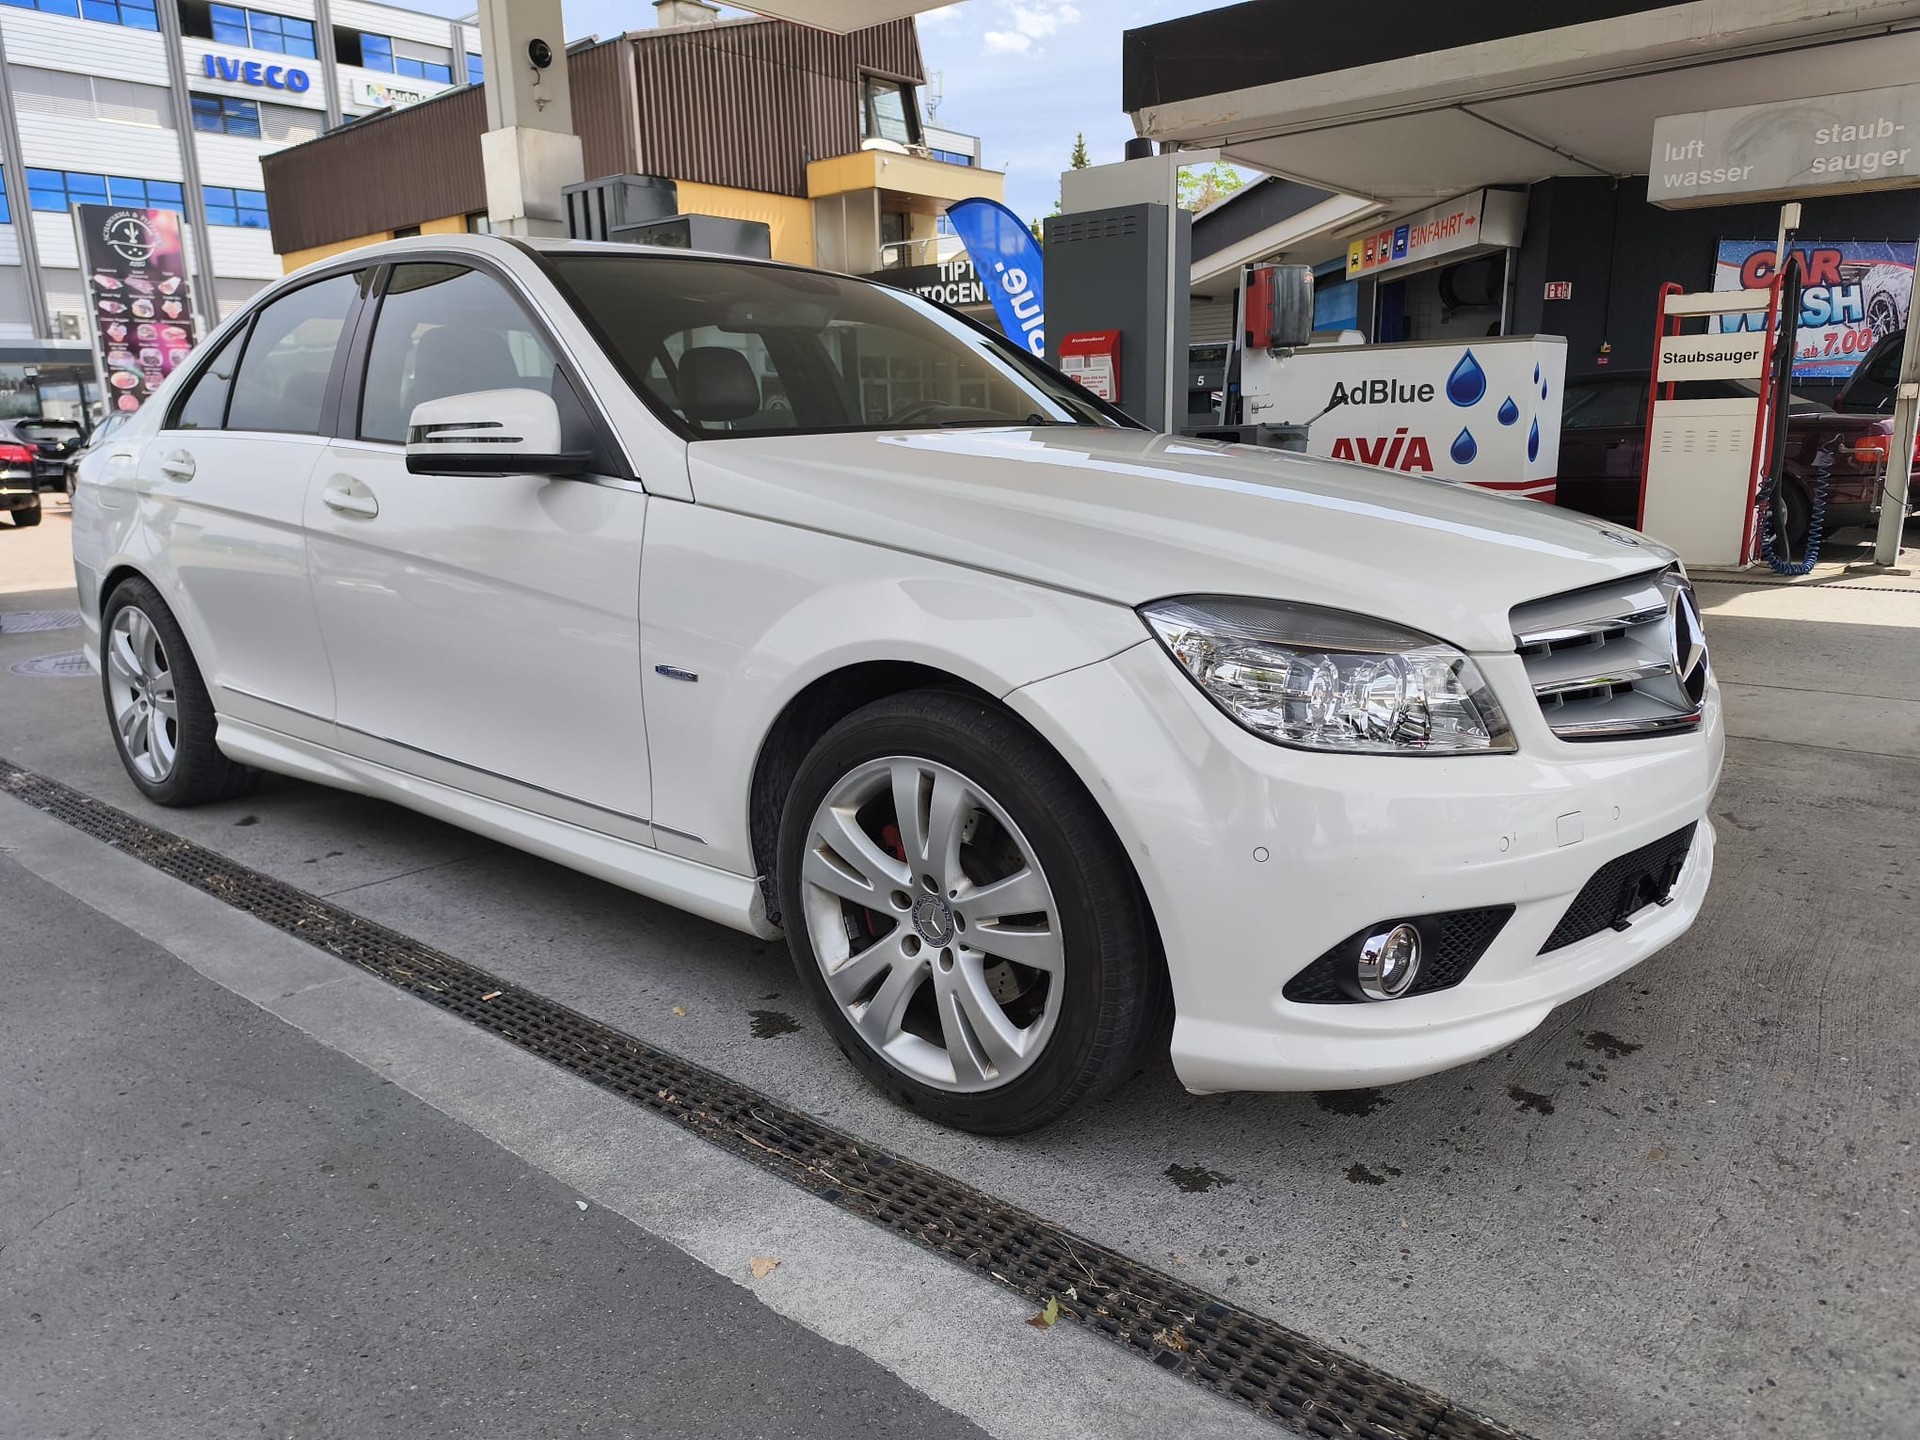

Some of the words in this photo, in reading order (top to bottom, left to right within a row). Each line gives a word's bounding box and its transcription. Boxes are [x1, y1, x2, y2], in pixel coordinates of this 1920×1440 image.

[203, 54, 310, 93] IVECO
[1815, 117, 1905, 145] staub-
[1664, 140, 1705, 162] luft
[1810, 148, 1911, 174] sauger
[1664, 164, 1753, 188] wasser
[1410, 212, 1464, 249] EINFAHRT
[937, 260, 977, 282] TIPT
[1803, 344, 1818, 358] ab
[1823, 329, 1872, 356] 7.00
[1663, 350, 1760, 364] Staubsauger
[1197, 375, 1205, 386] 5
[1329, 379, 1435, 406] AdBlue
